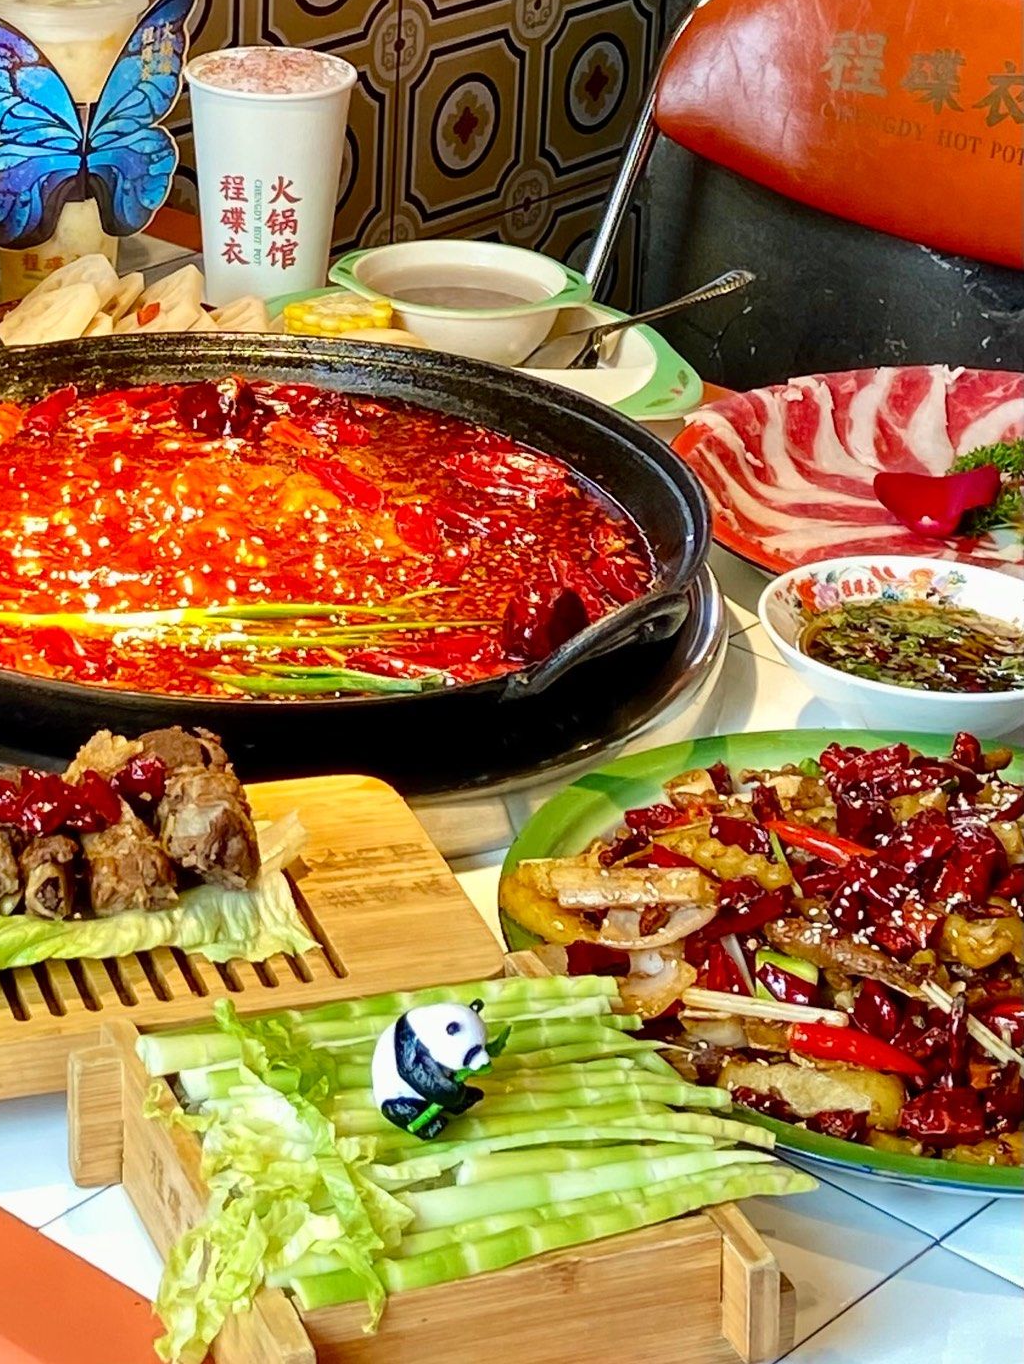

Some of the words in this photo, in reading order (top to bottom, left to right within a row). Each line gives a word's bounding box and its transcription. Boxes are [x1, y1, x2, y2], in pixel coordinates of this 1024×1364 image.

[936, 128, 982, 154] HOT
[219, 175, 250, 265] 程碟衣
[265, 175, 302, 270] 火锅馆
